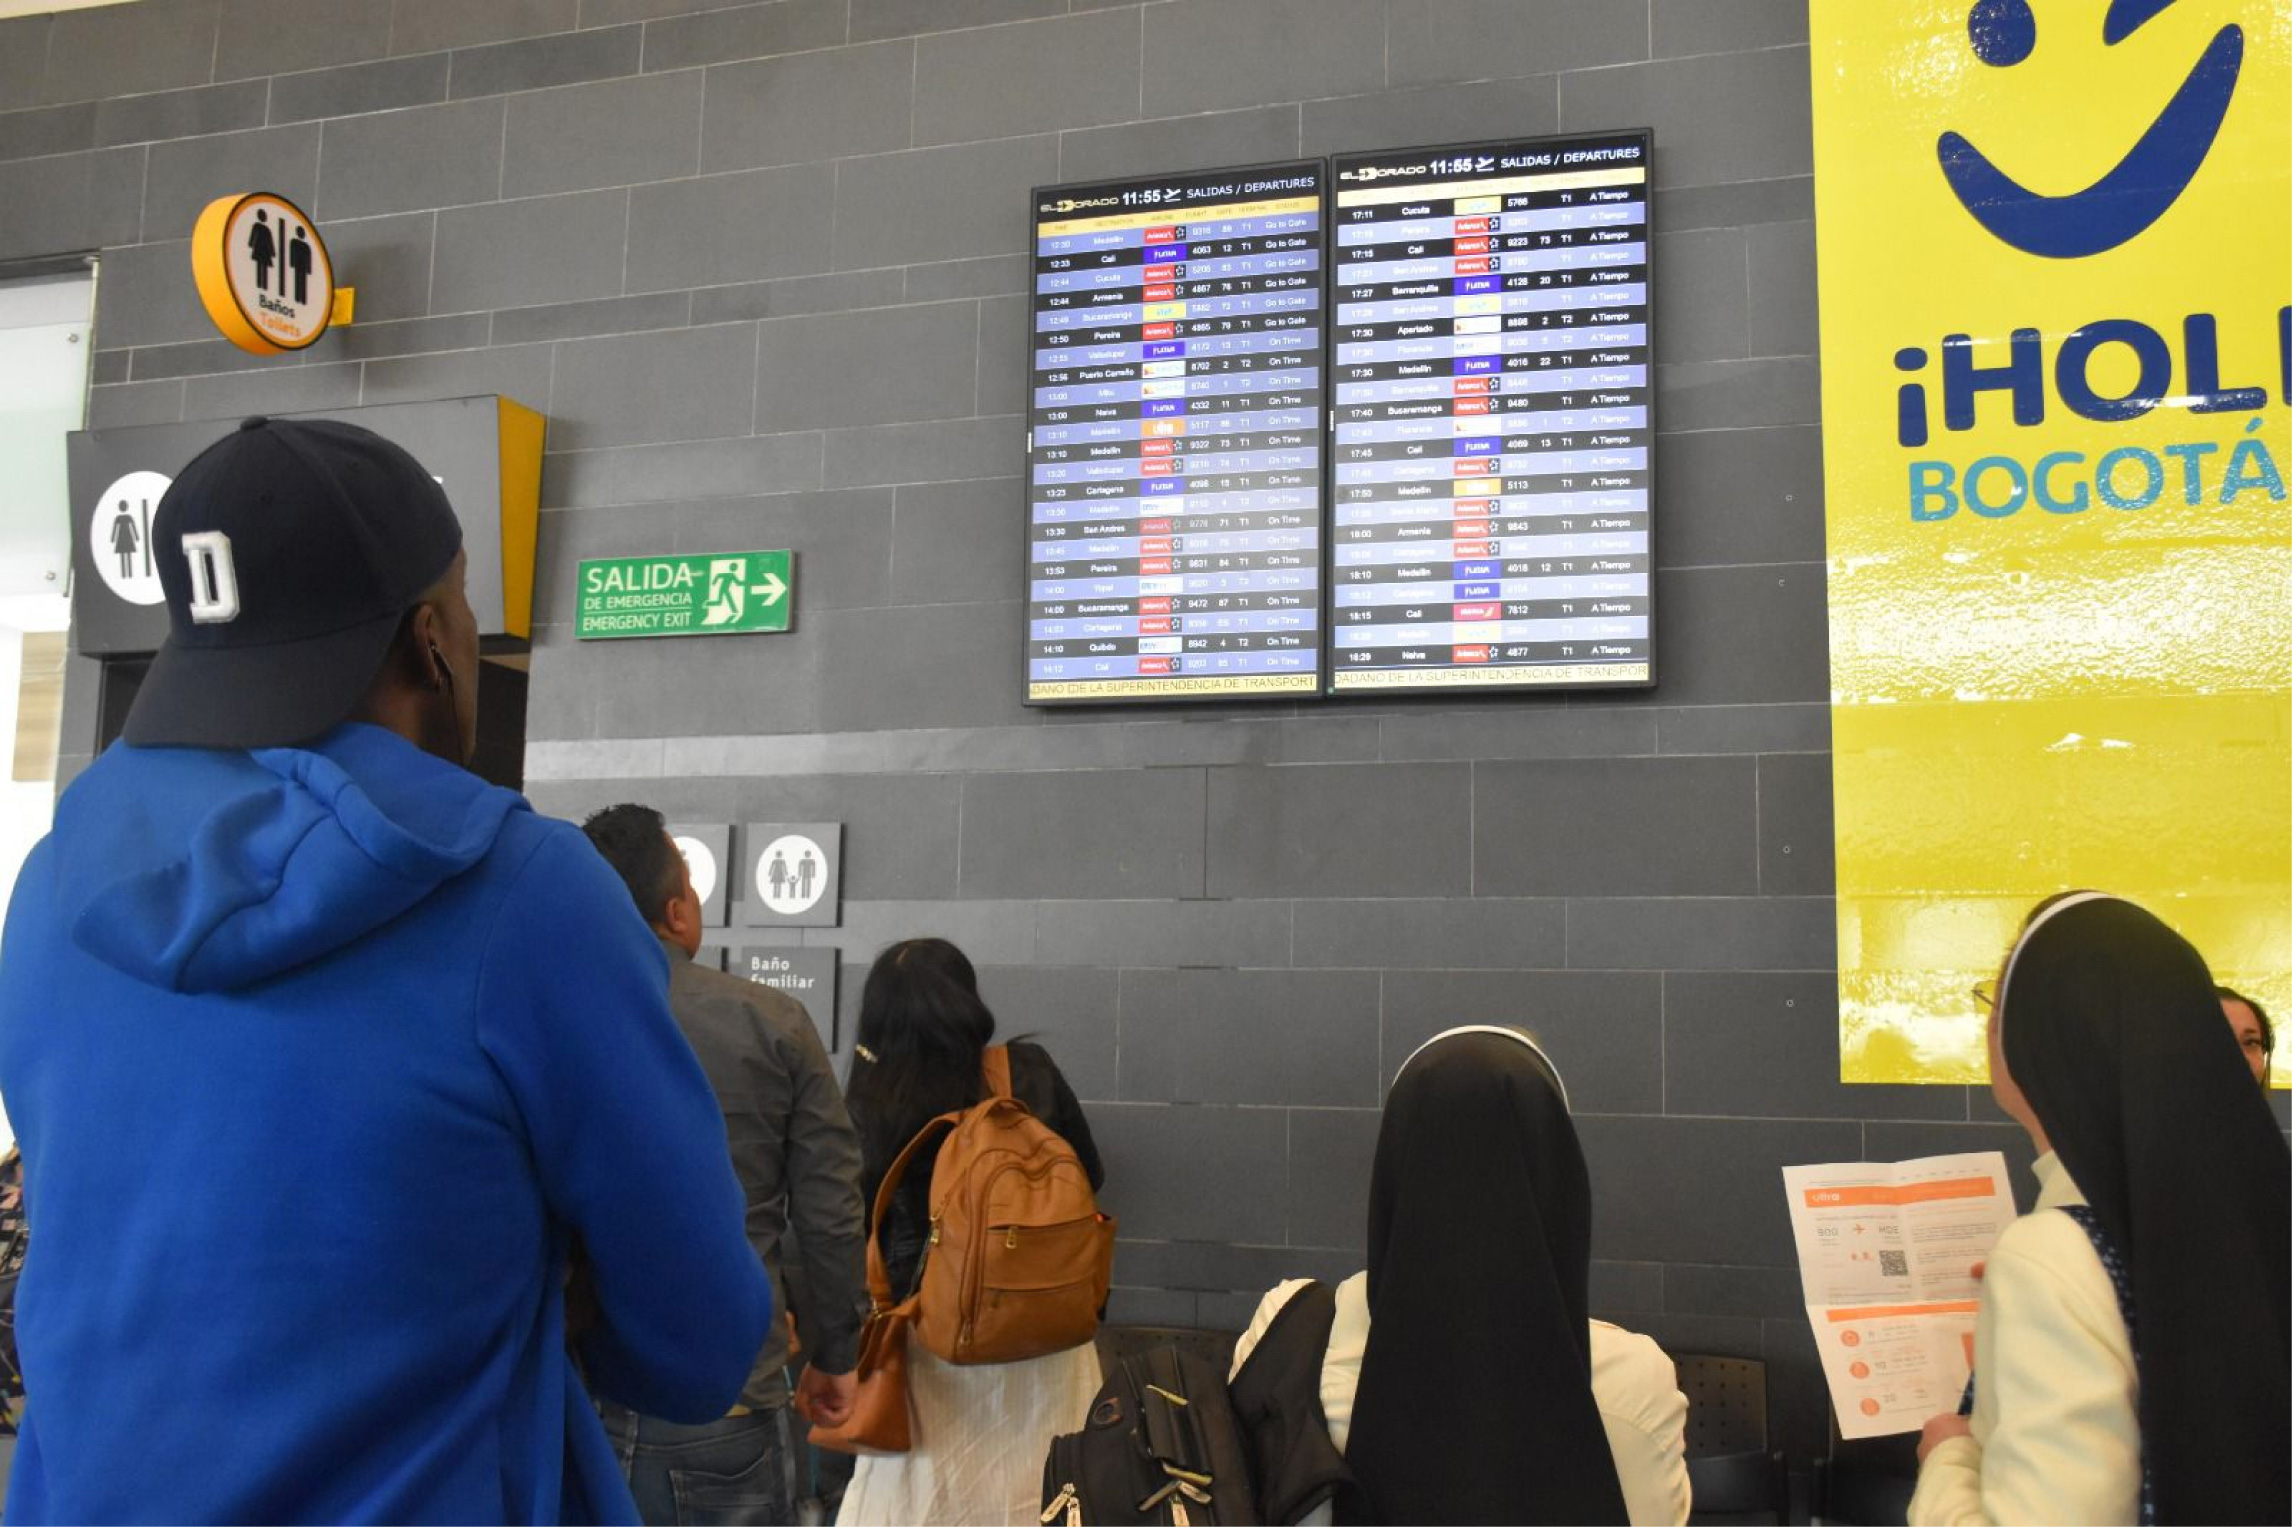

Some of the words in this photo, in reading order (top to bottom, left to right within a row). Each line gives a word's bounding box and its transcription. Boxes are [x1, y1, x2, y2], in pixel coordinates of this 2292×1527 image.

[1430, 157, 1471, 175] 11:55
[1500, 154, 1550, 168] SALIDAS
[1553, 154, 1559, 165] /
[1563, 147, 1640, 163] DEPARTURES
[1122, 189, 1160, 205] 11:55
[1186, 184, 1232, 198] SALIDAS
[1235, 183, 1240, 195] /
[1244, 176, 1315, 193] DEPARTURES
[1352, 210, 1372, 219] 17:11
[1401, 205, 1429, 215] Cucuta
[1561, 193, 1571, 202] T1
[1598, 190, 1628, 200] Tiempo
[1101, 254, 1115, 263] Cali
[1241, 242, 1250, 250] T1
[1265, 240, 1276, 249] Go
[1287, 237, 1306, 246] Gate
[1407, 245, 1423, 254] Cali
[1561, 234, 1571, 242] T1
[1598, 230, 1628, 240] Tiempo
[1092, 292, 1123, 301] Armenia
[1265, 279, 1276, 287] Go
[1287, 276, 1306, 285] Gate
[1352, 288, 1372, 298] 17:27
[1392, 284, 1438, 295] Barranquilla
[1561, 274, 1571, 282] T1
[1598, 270, 1628, 281] Tiempo
[258, 295, 295, 318] Baños
[260, 312, 301, 336] Toilets
[1094, 330, 1120, 340] Pereira
[1241, 319, 1250, 328] T1
[1264, 318, 1276, 326] Go
[1287, 316, 1306, 324] Gate
[1397, 324, 1433, 334] Apartado
[1561, 314, 1572, 323] T2
[1599, 311, 1629, 321] Tiempo
[1079, 370, 1103, 379] Puerto
[1269, 357, 1281, 365] On
[1283, 355, 1301, 364] Time
[1562, 355, 1571, 364] T1
[1599, 352, 1629, 362] Tiempo
[1893, 306, 2292, 447] ¡HOL
[1095, 408, 1116, 416] Neiva
[1240, 398, 1249, 406] T1
[1268, 396, 1280, 405] On
[1282, 395, 1300, 404] Time
[1351, 408, 1372, 417] 17:40
[1387, 405, 1442, 415] Bucaramanga
[1562, 396, 1571, 404] T1
[1599, 393, 1629, 403] Tiempo
[1240, 437, 1249, 446] T1
[1268, 436, 1280, 444] On
[1282, 435, 1300, 443] Time
[1407, 445, 1422, 454] Cali
[1562, 437, 1571, 445] T1
[1599, 435, 1630, 444] Tiempo
[1908, 418, 2287, 523] BOGOTÁ
[1086, 485, 1123, 495] Cartagena
[1240, 477, 1249, 485] T1
[1268, 476, 1279, 484] On
[1281, 475, 1300, 483] Time
[1507, 480, 1528, 489] 5113
[1562, 479, 1571, 487] T1
[1600, 476, 1630, 485] Tiempo
[1239, 517, 1249, 525] T1
[1268, 516, 1279, 524] On
[1281, 514, 1300, 523] Time
[1397, 527, 1431, 536] Armenia
[1562, 520, 1571, 528] T1
[1600, 518, 1630, 527] Tiempo
[1090, 564, 1117, 572] Pereira
[1239, 557, 1248, 565] T1
[1267, 556, 1279, 564] On
[1281, 555, 1299, 564] Time
[1562, 562, 1572, 570] T1
[1599, 560, 1630, 569] Tiempo
[181, 530, 241, 625] D
[586, 562, 694, 593] SALIDA
[584, 596, 602, 610] DE
[606, 592, 692, 609] EMERGENCIA
[1078, 603, 1128, 613] Bucaramanga
[1267, 596, 1279, 605] On
[1281, 596, 1299, 604] Time
[1406, 609, 1421, 617] Cali
[1562, 604, 1572, 612] T1
[1600, 602, 1630, 612] Tiempo
[583, 613, 659, 631] EMERGENCY
[663, 612, 691, 627] EXIT
[1267, 637, 1279, 645] On
[1281, 636, 1299, 644] Time
[1402, 651, 1425, 659] Neiva
[1562, 646, 1572, 654] T1
[1599, 645, 1630, 654] Tiempo
[1089, 683, 1102, 692] LA
[1105, 678, 1221, 692] SUPERINTENDENCIA
[1224, 678, 1239, 688] DE
[1243, 675, 1313, 688] TRANSPORT
[1388, 672, 1406, 682] DE
[1408, 671, 1422, 681] LA
[1424, 668, 1551, 681] SUPERINTENDENCIA
[1556, 667, 1571, 677] DE
[751, 956, 790, 971] Baño
